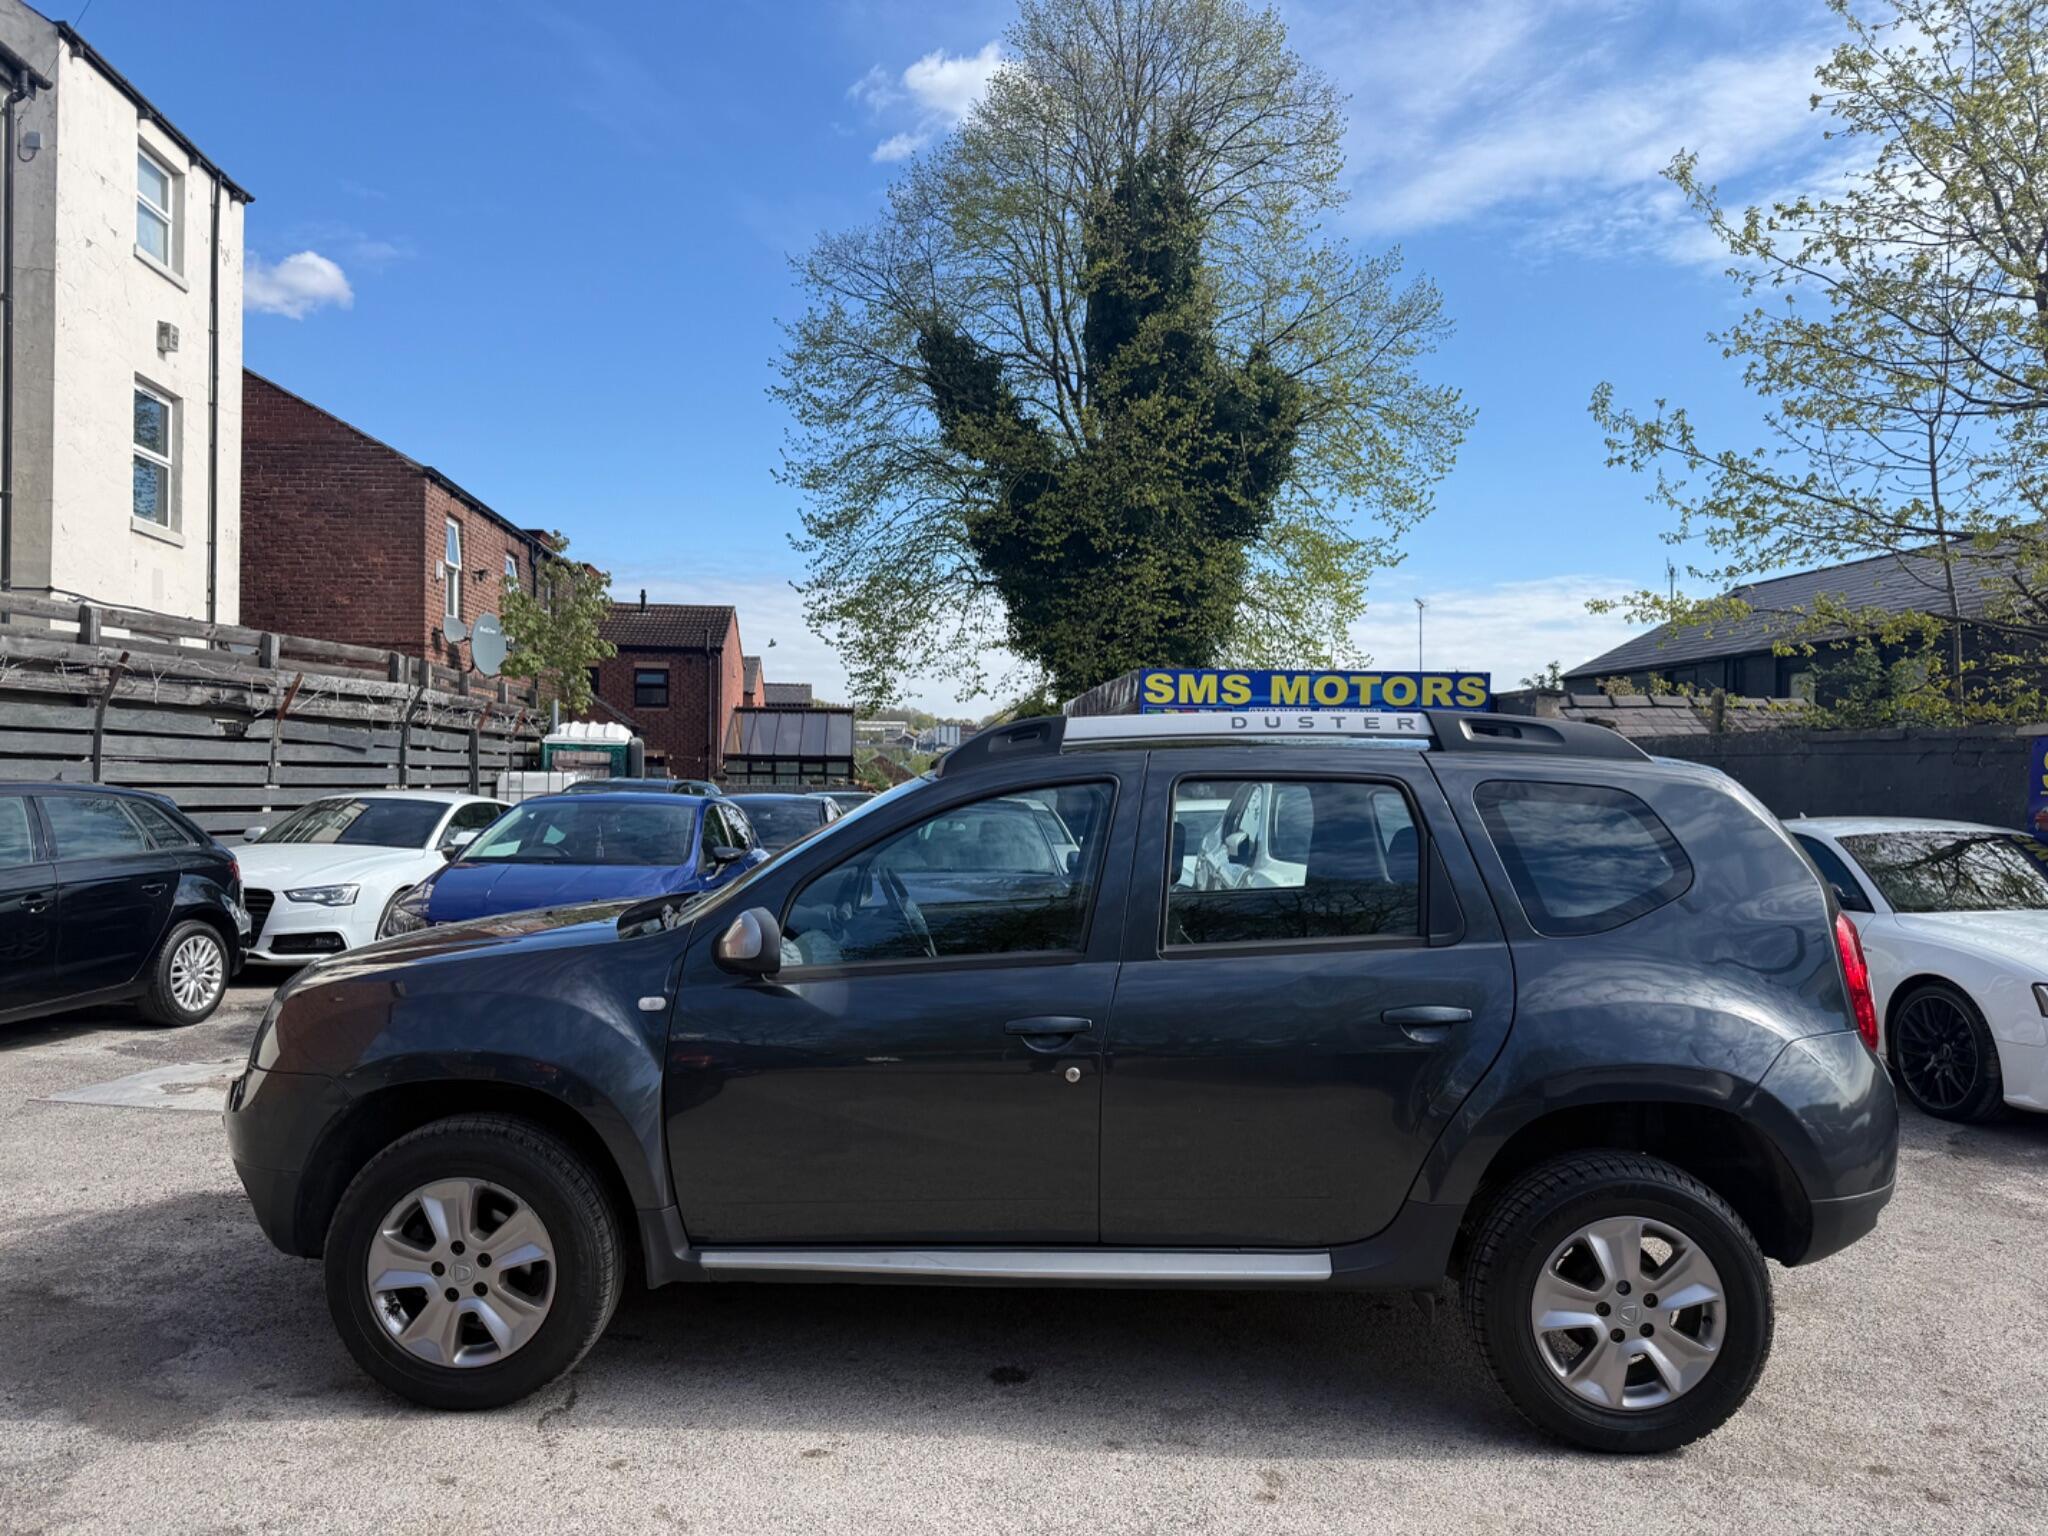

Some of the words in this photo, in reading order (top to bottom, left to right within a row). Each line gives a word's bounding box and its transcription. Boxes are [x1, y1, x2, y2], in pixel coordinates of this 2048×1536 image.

[1144, 673, 1252, 705] SMS
[1272, 675, 1487, 707] MOTORS
[1231, 716, 1417, 730] DUSTER
